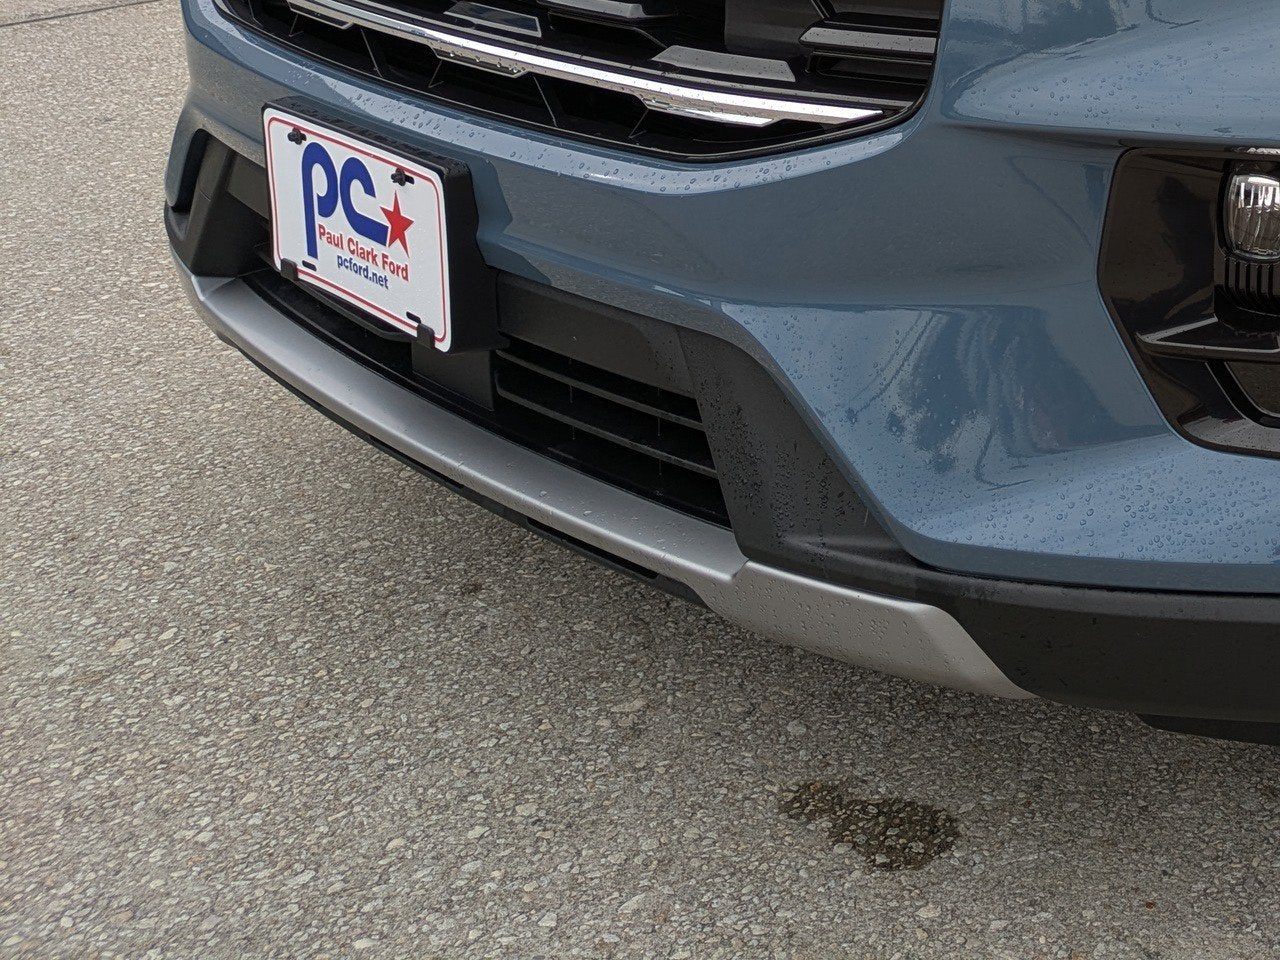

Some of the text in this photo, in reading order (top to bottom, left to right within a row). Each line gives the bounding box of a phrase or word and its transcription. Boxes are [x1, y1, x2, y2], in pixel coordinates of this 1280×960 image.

[318, 223, 409, 282] Paul Clark Ford
[336, 254, 389, 290] pcford.net
